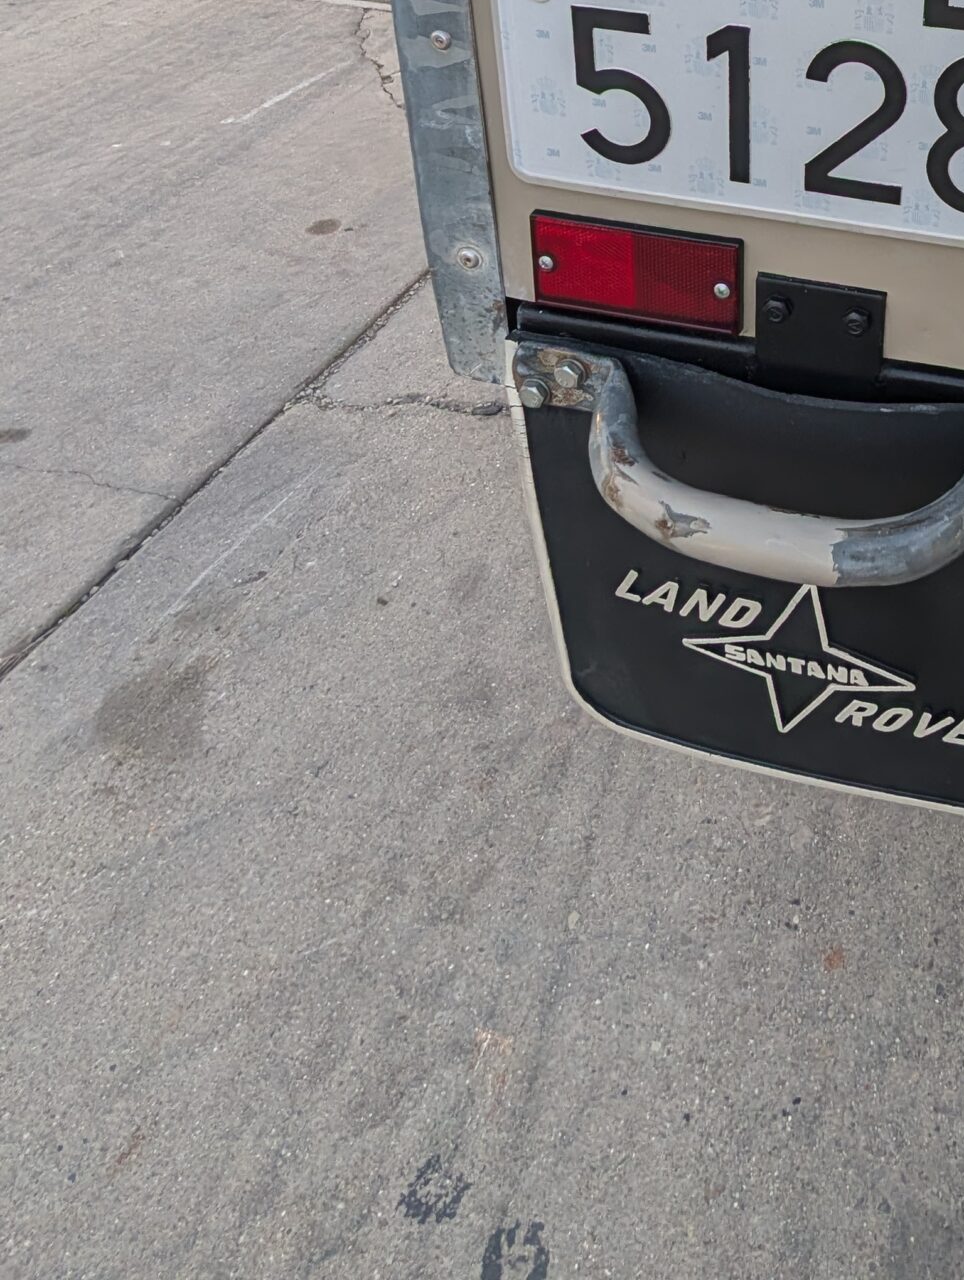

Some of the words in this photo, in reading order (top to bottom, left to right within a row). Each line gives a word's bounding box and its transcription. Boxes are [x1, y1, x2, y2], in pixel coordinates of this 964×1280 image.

[536, 30, 550, 39] 3M
[642, 44, 656, 52] 3M
[753, 57, 767, 66] 3M
[592, 99, 606, 107] 3M
[698, 112, 712, 121] 3M
[806, 126, 821, 136] 3M
[547, 148, 560, 157] 3M
[648, 164, 661, 172] 3M
[752, 178, 767, 187] 3M
[615, 569, 763, 628] LAND
[724, 643, 869, 686] SANTANA
